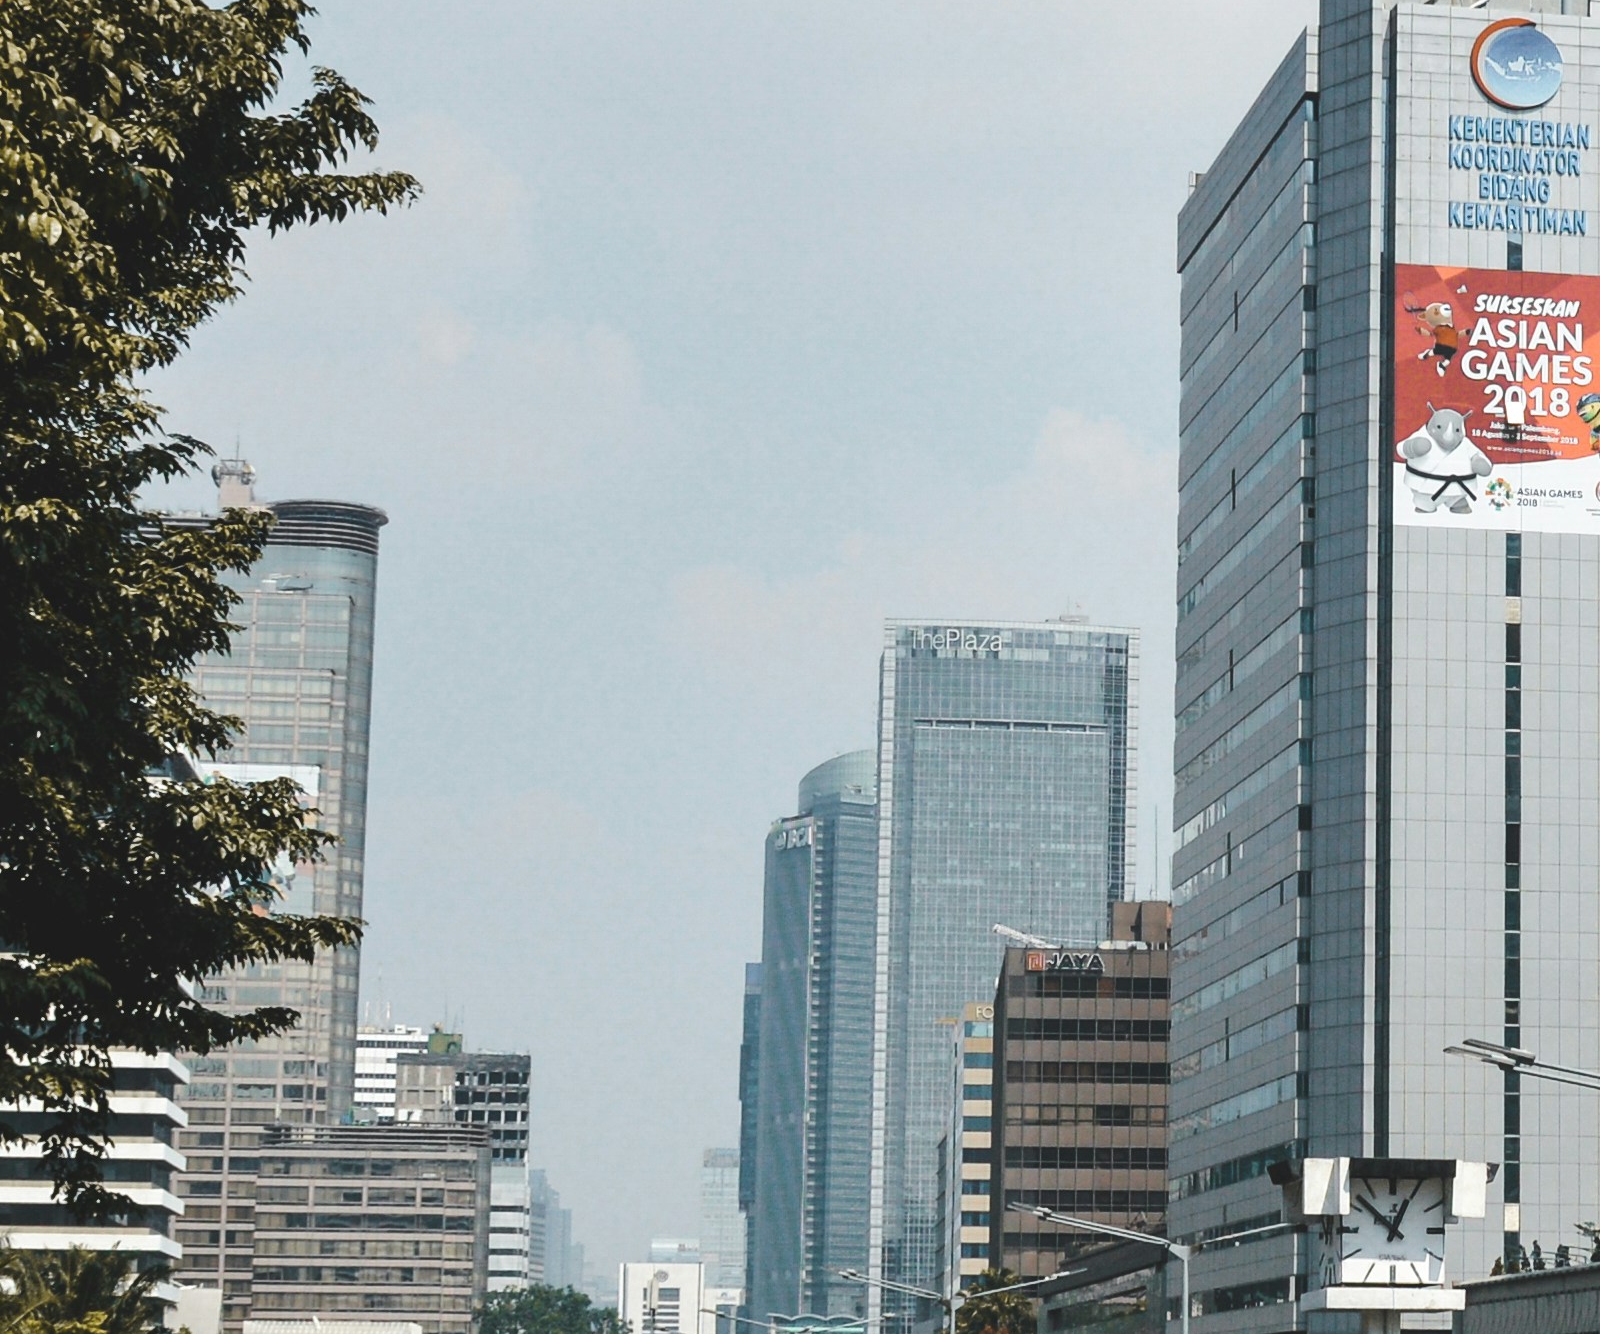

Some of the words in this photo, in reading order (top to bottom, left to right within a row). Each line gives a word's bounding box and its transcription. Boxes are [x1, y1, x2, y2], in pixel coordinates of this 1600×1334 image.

[1449, 115, 1590, 150] KEMENTERIAN
[1449, 143, 1581, 177] KOORDINATOR
[1479, 173, 1550, 204] BIDANG
[1449, 201, 1587, 236] KEMARITIMAN
[1474, 294, 1581, 318] SUKSESKAN
[1468, 317, 1584, 353] ASIAN
[1461, 349, 1593, 386] GAMES
[1483, 384, 1571, 417] 2018
[1517, 487, 1547, 498] ASIAN
[1549, 489, 1584, 499] GAMES
[1517, 497, 1538, 507] 2018
[1045, 952, 1106, 972] JAYA
